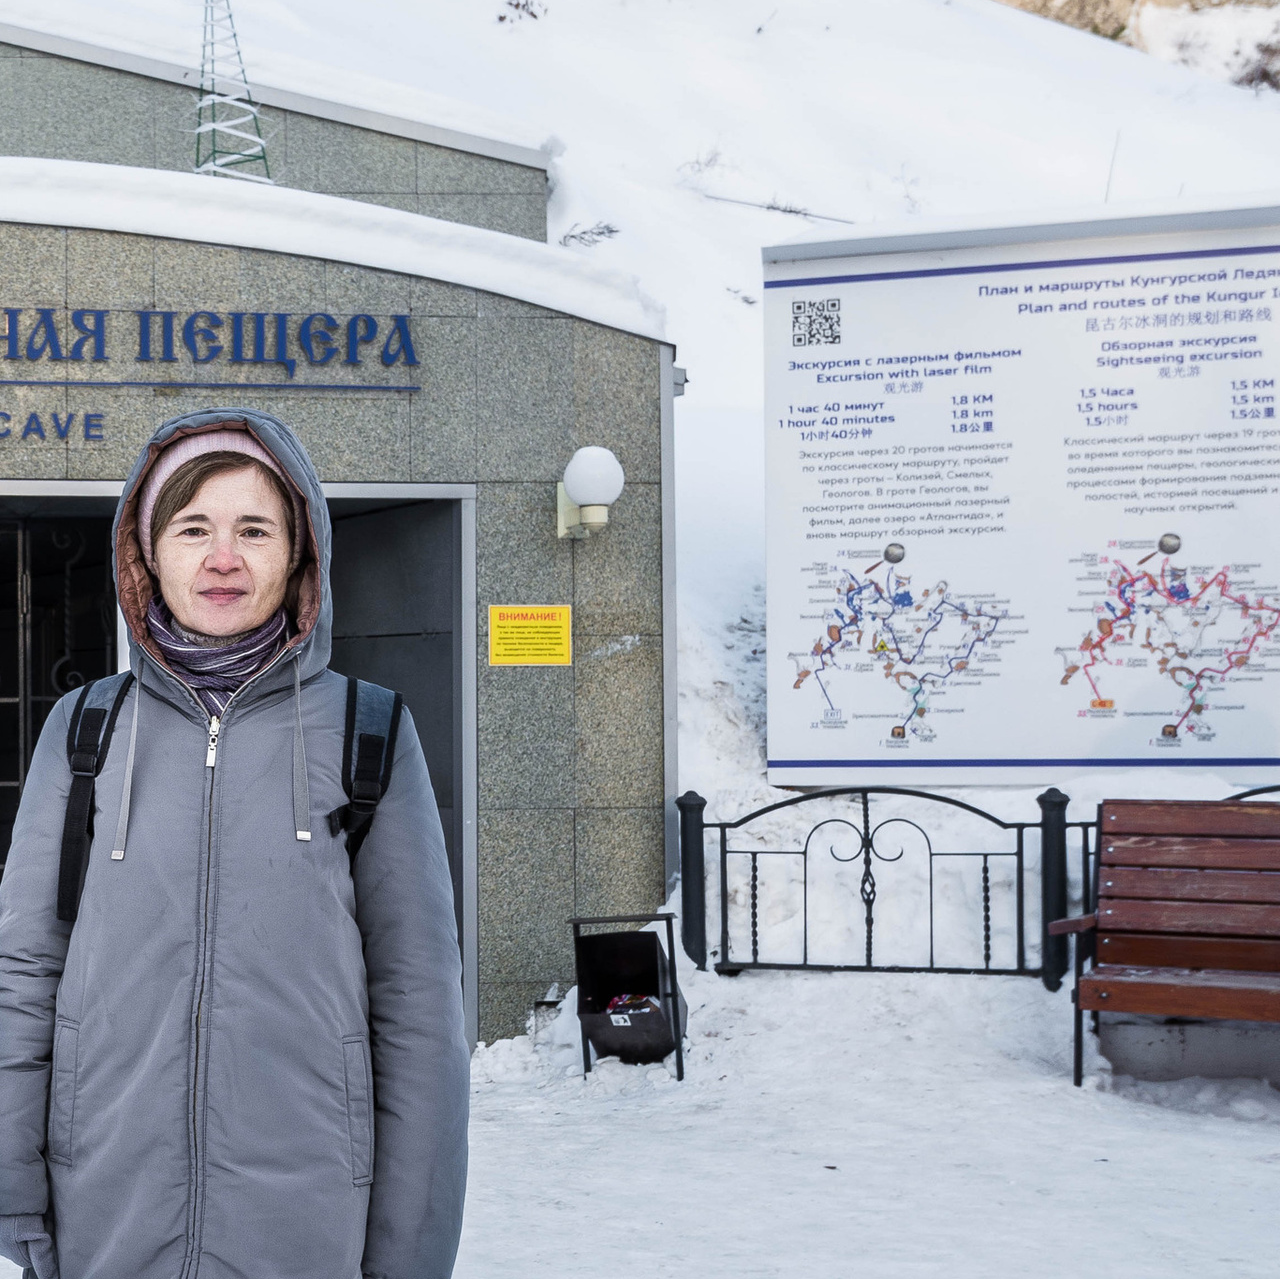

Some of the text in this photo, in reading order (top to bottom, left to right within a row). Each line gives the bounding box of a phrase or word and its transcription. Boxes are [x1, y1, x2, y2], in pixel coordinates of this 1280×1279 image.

[978, 285, 1018, 297] План
[1024, 285, 1033, 294] и
[1038, 279, 1124, 294] маршруты
[1130, 268, 1227, 288] Кунгурской
[1018, 300, 1053, 314] Plan
[1059, 299, 1088, 312] and
[1093, 297, 1146, 310] routes
[1151, 294, 1169, 306] of
[1174, 292, 1200, 305] the
[1207, 291, 1266, 303] Kungur
[1085, 307, 1272, 332] 昆古尔冰洞的规划和路线
[136, 310, 421, 379] ПЕЩЕРА
[1101, 335, 1257, 352] Обзорная экскурсия
[788, 349, 1022, 372] Экскурсия с лазерным фильмом
[1096, 349, 1263, 368] Sightseeing excursion
[816, 364, 992, 384] Excursion with laser film
[1101, 387, 1135, 397] Часа
[1252, 379, 1274, 389] КМ
[972, 394, 994, 404] КМ
[1098, 402, 1138, 412] hours
[1253, 394, 1275, 404] km
[788, 402, 885, 414] 1 час 40 минут
[973, 408, 994, 418] km
[778, 414, 896, 429] 1 hour 40 minutes
[1063, 434, 1144, 447] Классический
[1147, 434, 1201, 444] маршрут
[1204, 432, 1239, 442] через
[1242, 428, 1254, 438] 19
[799, 442, 1013, 461] Экскурсия через 20 гротов начинается
[1084, 451, 1119, 461] время
[1121, 448, 1174, 459] которого
[802, 455, 1009, 473] по классическому маршруту, пройдет
[1067, 464, 1144, 475] оледенением
[818, 477, 849, 487] через
[852, 475, 885, 487] гроты
[896, 472, 944, 482] Колизей,
[946, 470, 993, 480] Смелых,
[1066, 478, 1136, 490] процессами
[1139, 474, 1227, 487] формирования
[822, 489, 872, 499] Геологов.
[876, 488, 883, 497] В
[886, 488, 916, 497] гроте
[919, 485, 970, 495] Геологов,
[1143, 488, 1198, 500] историей
[1201, 485, 1268, 497] посещений
[802, 495, 1010, 513] посмотрите анимационный лазерный
[1123, 506, 1175, 515] научных
[808, 518, 846, 528] фильм,
[848, 516, 881, 526] далее
[883, 515, 916, 524] озеро
[805, 524, 1007, 540] вновь маршрут обзорной экскурсии.
